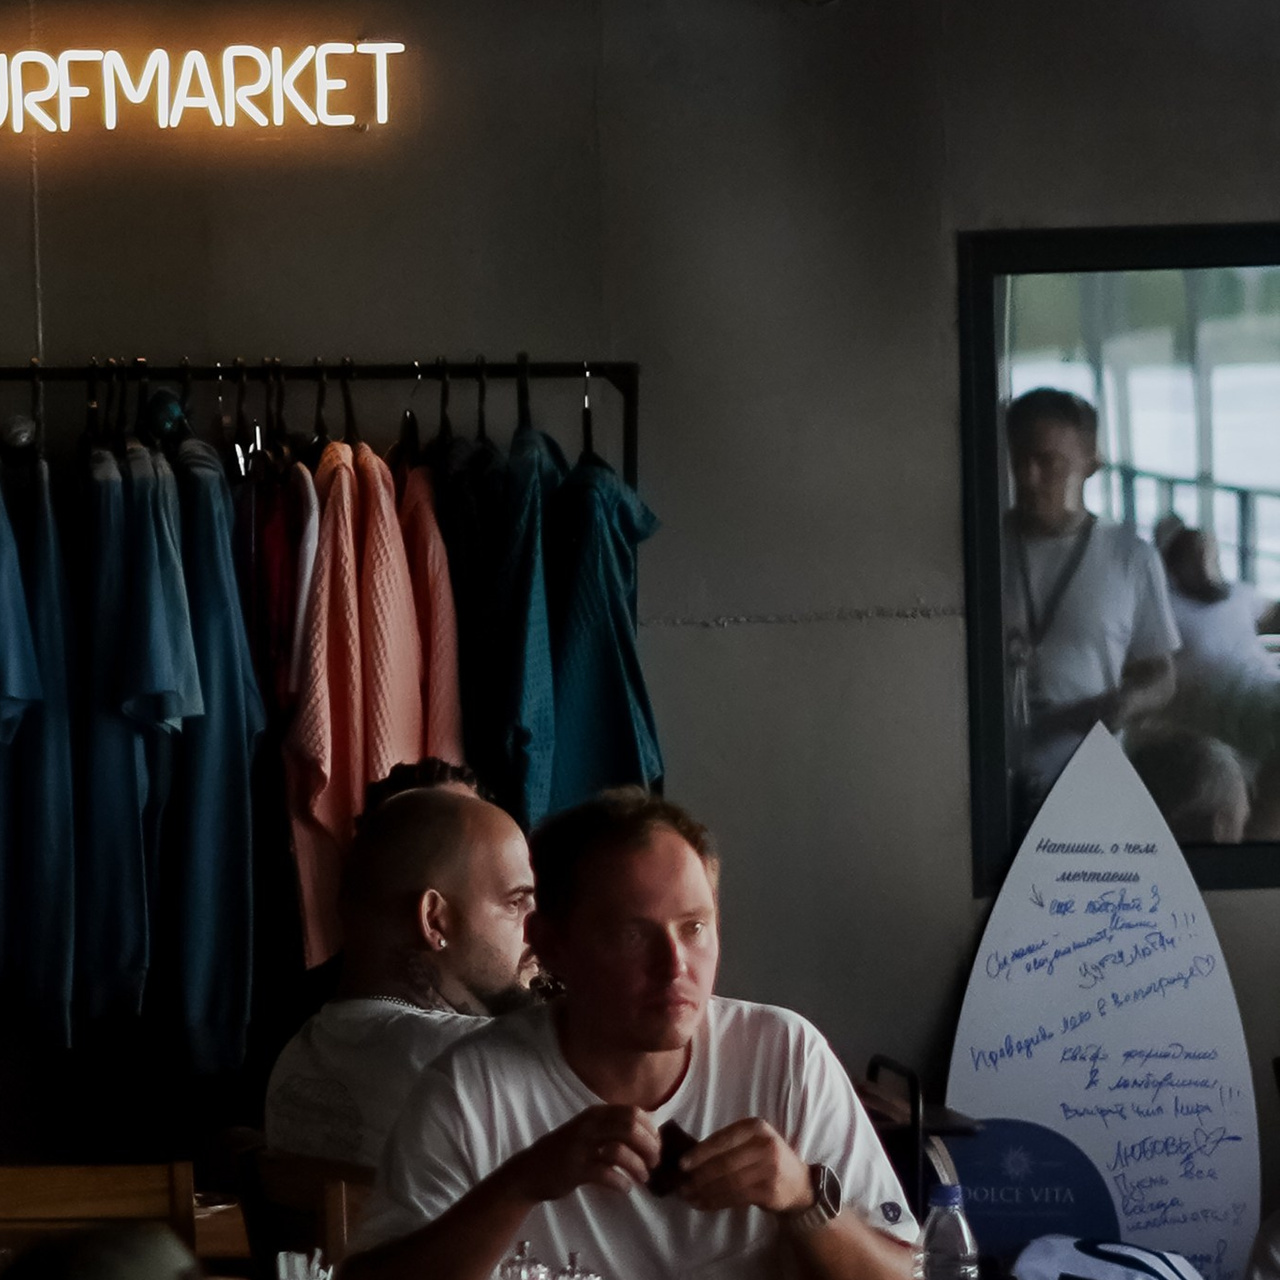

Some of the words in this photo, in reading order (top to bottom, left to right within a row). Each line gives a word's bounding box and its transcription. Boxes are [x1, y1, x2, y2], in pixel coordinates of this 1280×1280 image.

[1109, 841, 1119, 854] о
[1123, 841, 1157, 855] чем
[1054, 869, 1140, 883] мечтаешь
[1030, 1187, 1075, 1204] VITA
